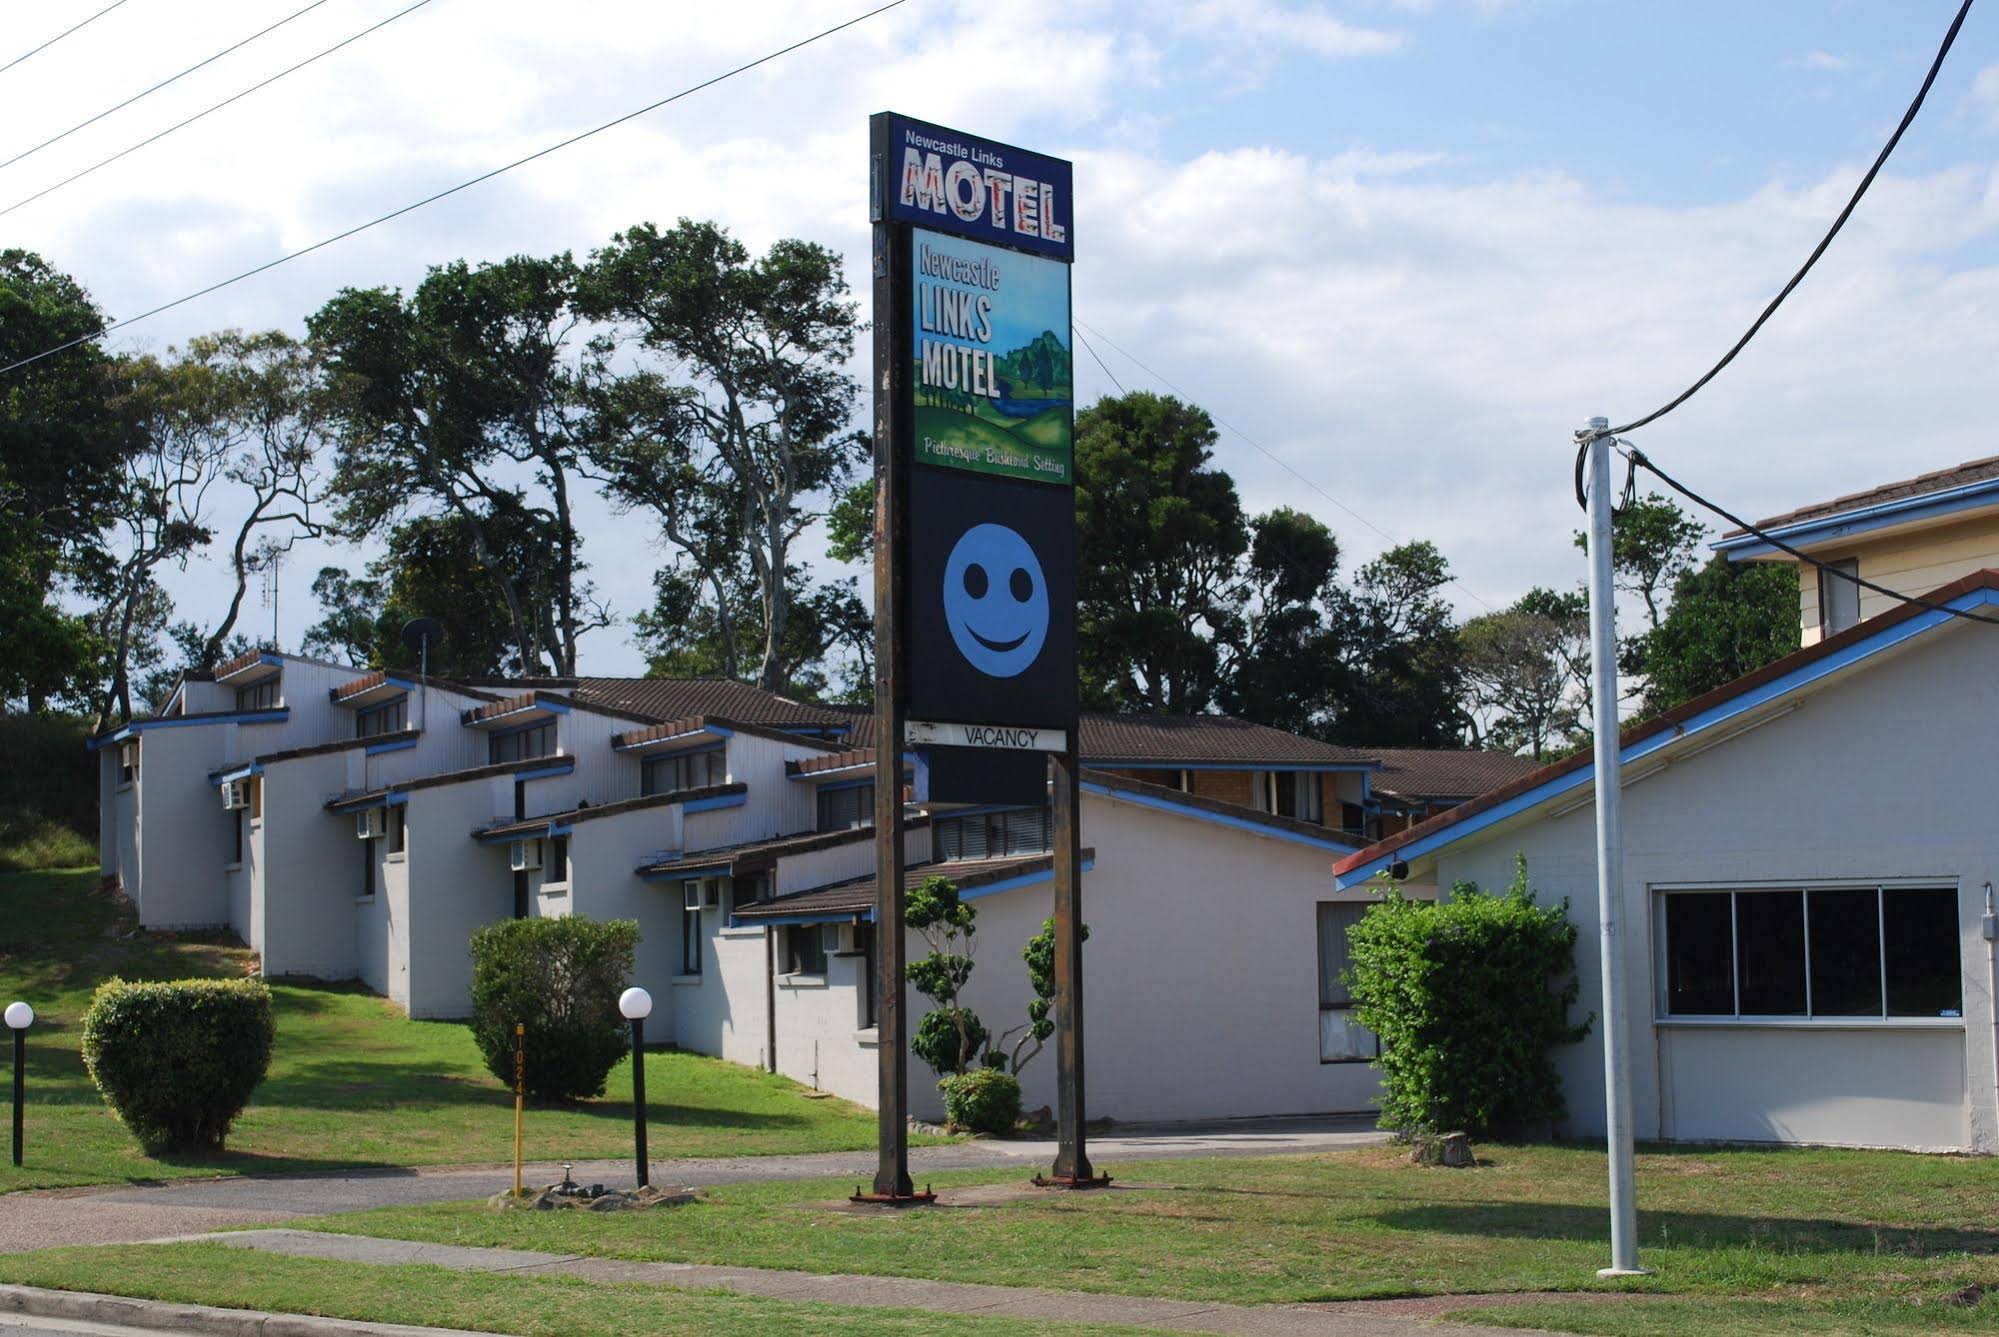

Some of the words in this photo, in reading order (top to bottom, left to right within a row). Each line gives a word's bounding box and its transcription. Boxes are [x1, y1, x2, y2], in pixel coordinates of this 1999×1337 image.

[905, 129, 969, 159] Newcastle
[971, 147, 1004, 168] Links
[900, 147, 1066, 244] MOTEL
[920, 243, 1000, 291] Newcastle
[920, 282, 992, 344] LINKS
[921, 338, 1001, 399] MOTEL
[924, 437, 980, 463] Picturesque
[985, 447, 1029, 468] Bushland
[1034, 455, 1065, 477] Setting
[965, 727, 1038, 748] VACANCY
[515, 1036, 525, 1094] 1024
